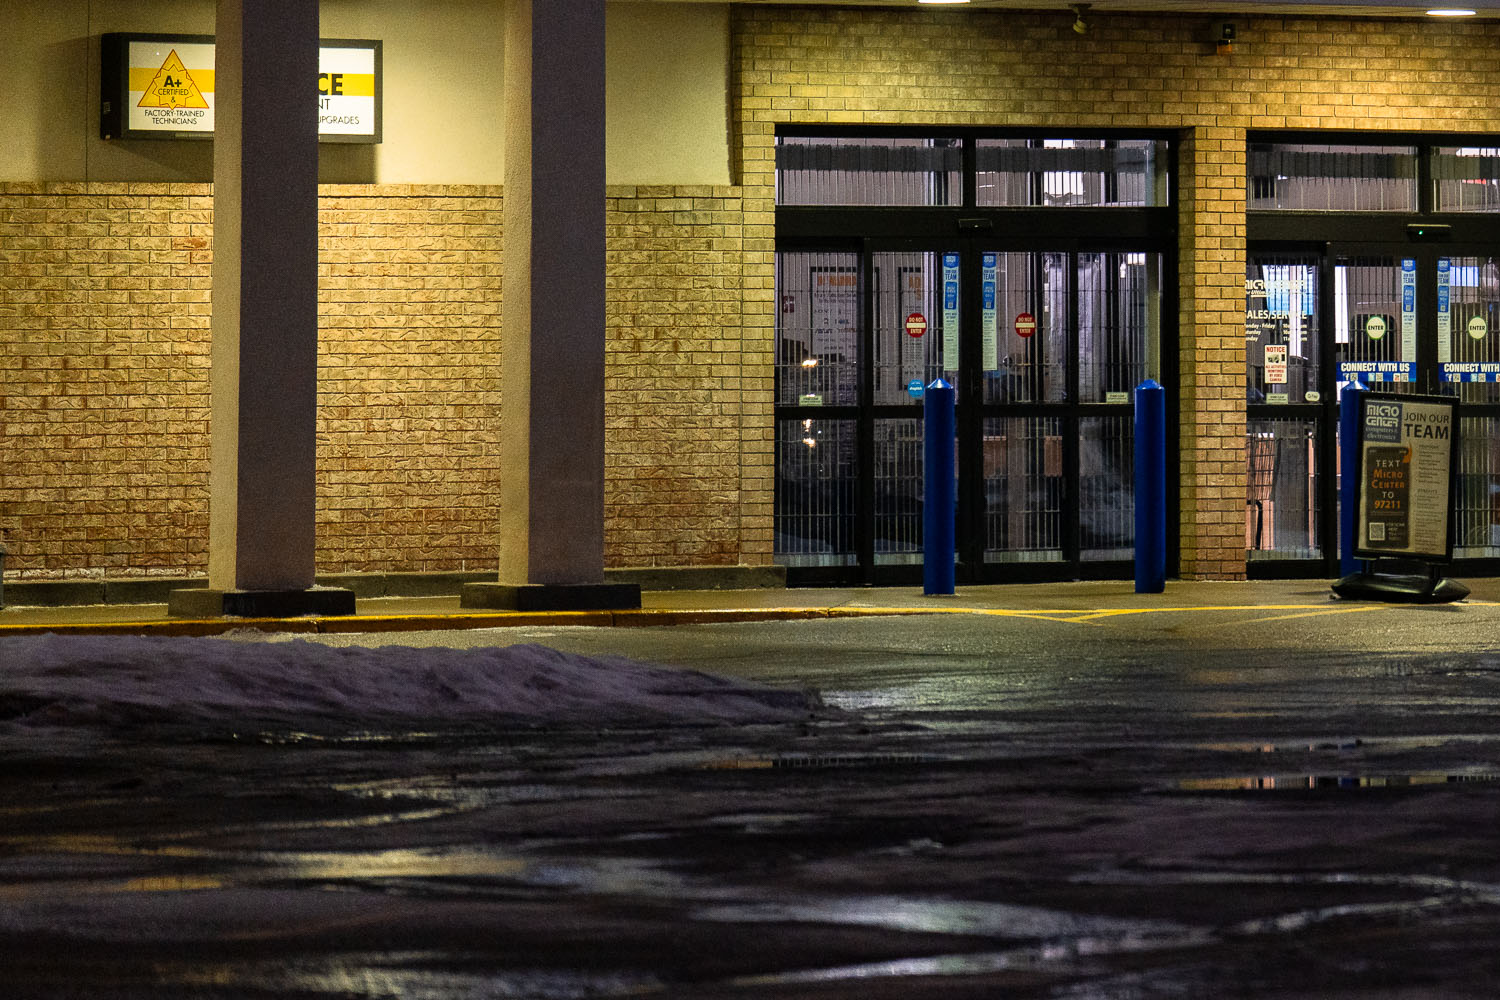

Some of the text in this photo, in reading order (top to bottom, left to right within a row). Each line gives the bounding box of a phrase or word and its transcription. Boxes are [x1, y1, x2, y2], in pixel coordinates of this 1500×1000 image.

[163, 75, 182, 88] A+
[158, 88, 189, 96] CERTIFIED
[144, 109, 205, 117] FACTORY-TRAINED
[1341, 363, 1410, 372] CONNECT WITH US
[1444, 364, 1479, 372] CONNECT
[1481, 364, 1500, 372] WITH
[1367, 405, 1399, 417] MICRO
[1366, 416, 1398, 427] CENTER
[1404, 413, 1449, 424] JOIN OUR
[1404, 424, 1448, 439] TEAM
[1376, 460, 1400, 468] TEXT
[1375, 500, 1400, 509] 97211
